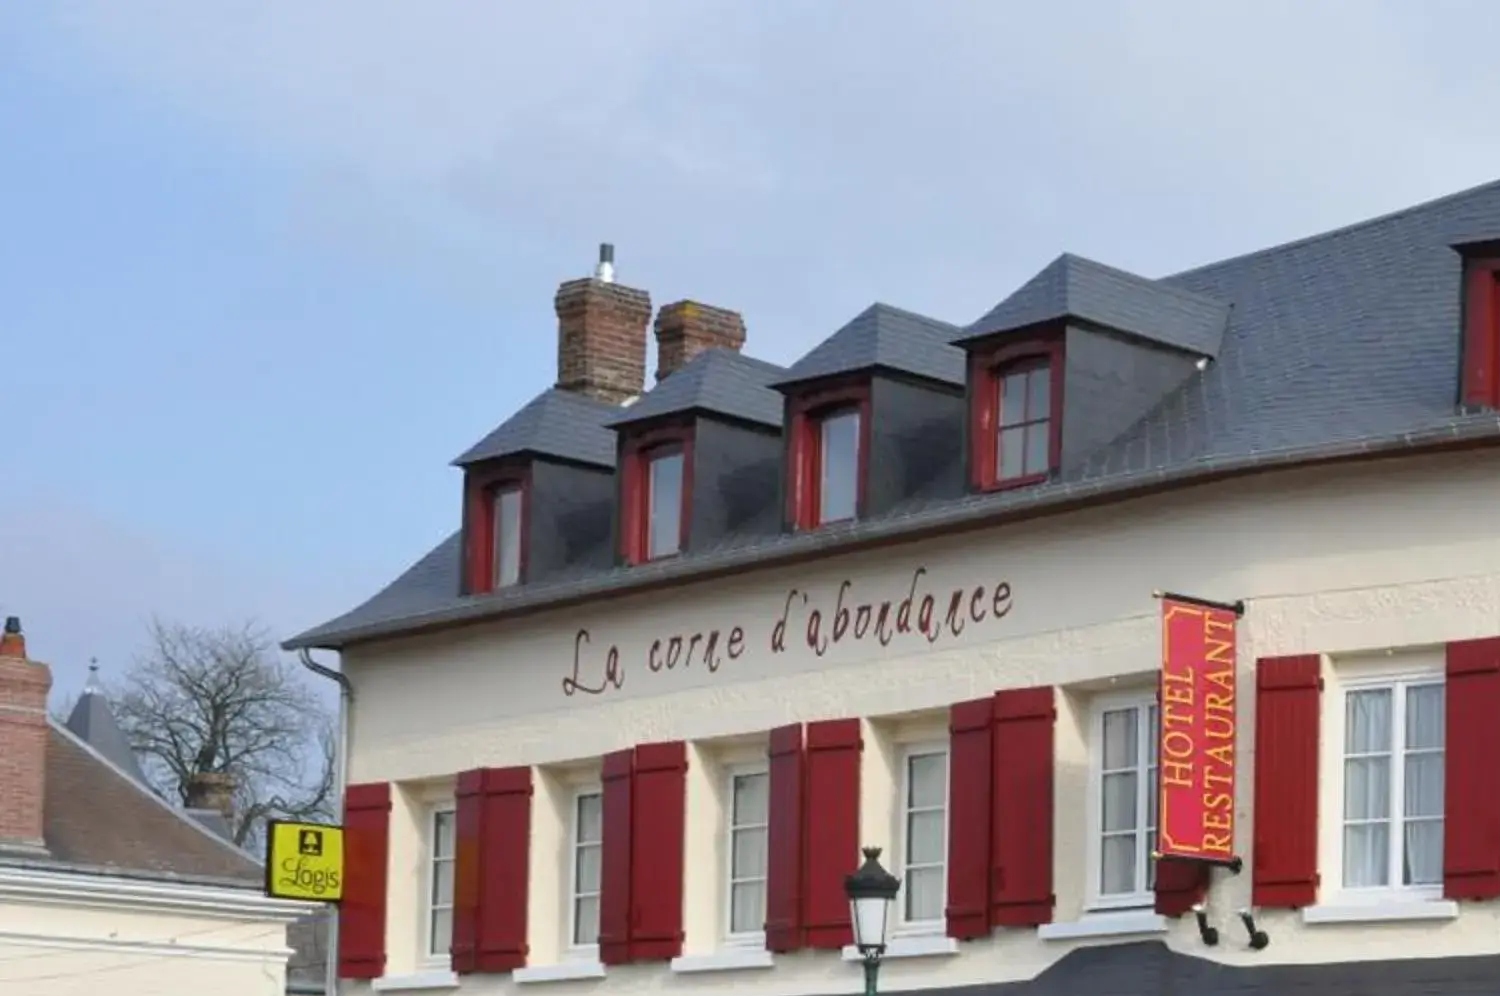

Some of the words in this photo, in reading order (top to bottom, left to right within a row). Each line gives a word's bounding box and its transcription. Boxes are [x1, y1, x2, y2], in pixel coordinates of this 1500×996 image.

[562, 628, 624, 696] La
[648, 625, 746, 673] corne
[771, 567, 1013, 657] d'abondance
[1163, 665, 1194, 788] HOTEL
[1202, 611, 1235, 852] RESTAURANT
